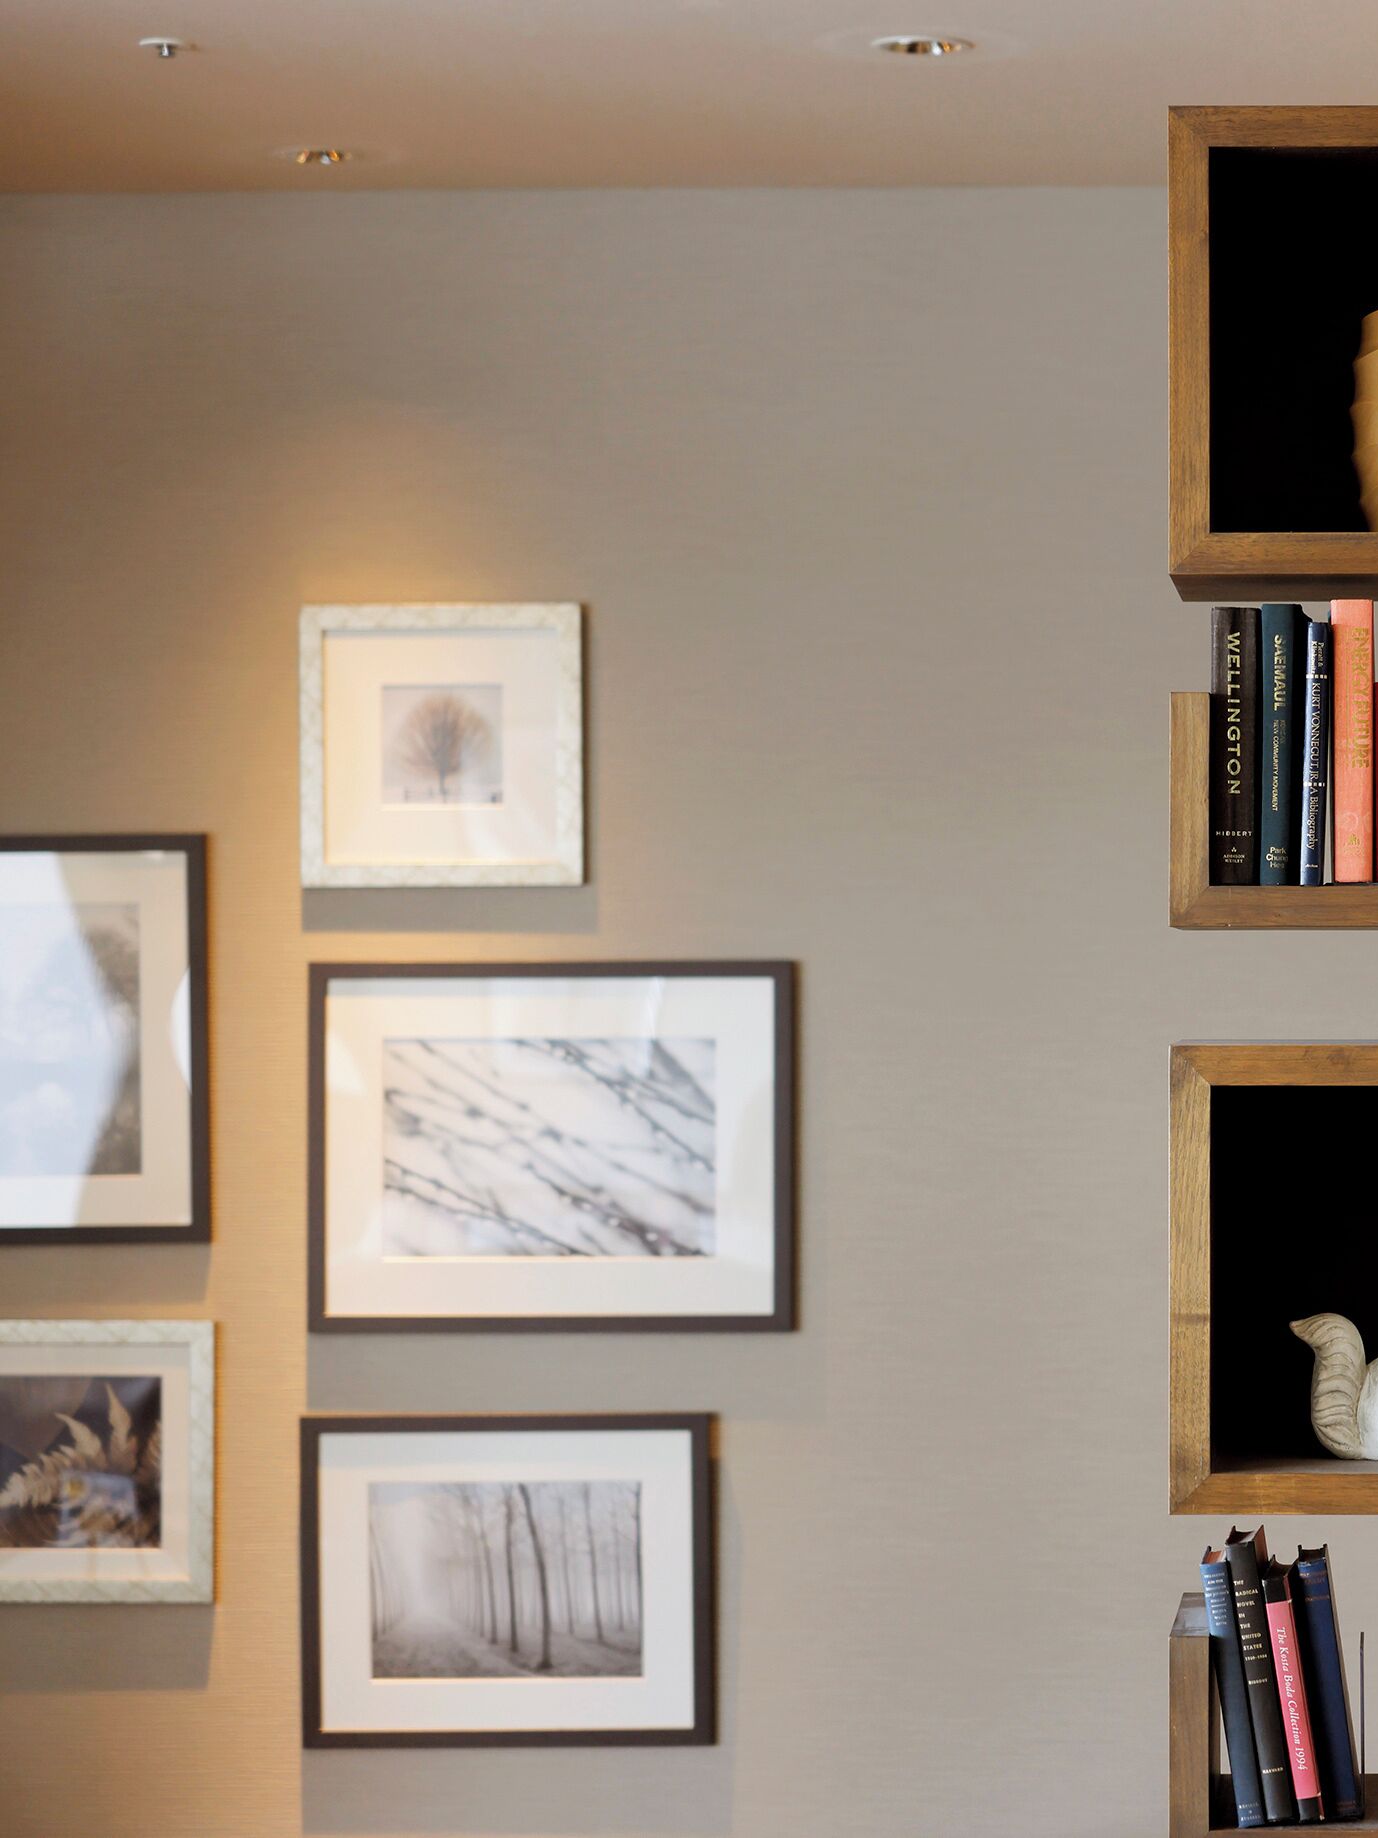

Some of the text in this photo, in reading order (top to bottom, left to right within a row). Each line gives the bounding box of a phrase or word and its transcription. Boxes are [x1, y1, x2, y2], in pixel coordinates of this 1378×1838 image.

[1273, 634, 1287, 712] SAEMAUL
[1226, 631, 1241, 795] WELLINGTON
[1311, 682, 1321, 708] KURT
[1352, 627, 1370, 769] ENERGY FUTURE
[1272, 735, 1280, 775] COMMUNITY
[1309, 710, 1321, 770] VONNEGUT,
[1271, 775, 1279, 812] MOVEMENT
[1309, 786, 1319, 794] A
[1306, 796, 1320, 850] Bibliography
[1269, 846, 1287, 854] Park
[1235, 1588, 1259, 1597] RADICAL
[1237, 1600, 1256, 1608] NOVEL
[1241, 1632, 1262, 1640] UNITED
[1277, 1626, 1308, 1771] The Kosta Boda Collection 1994
